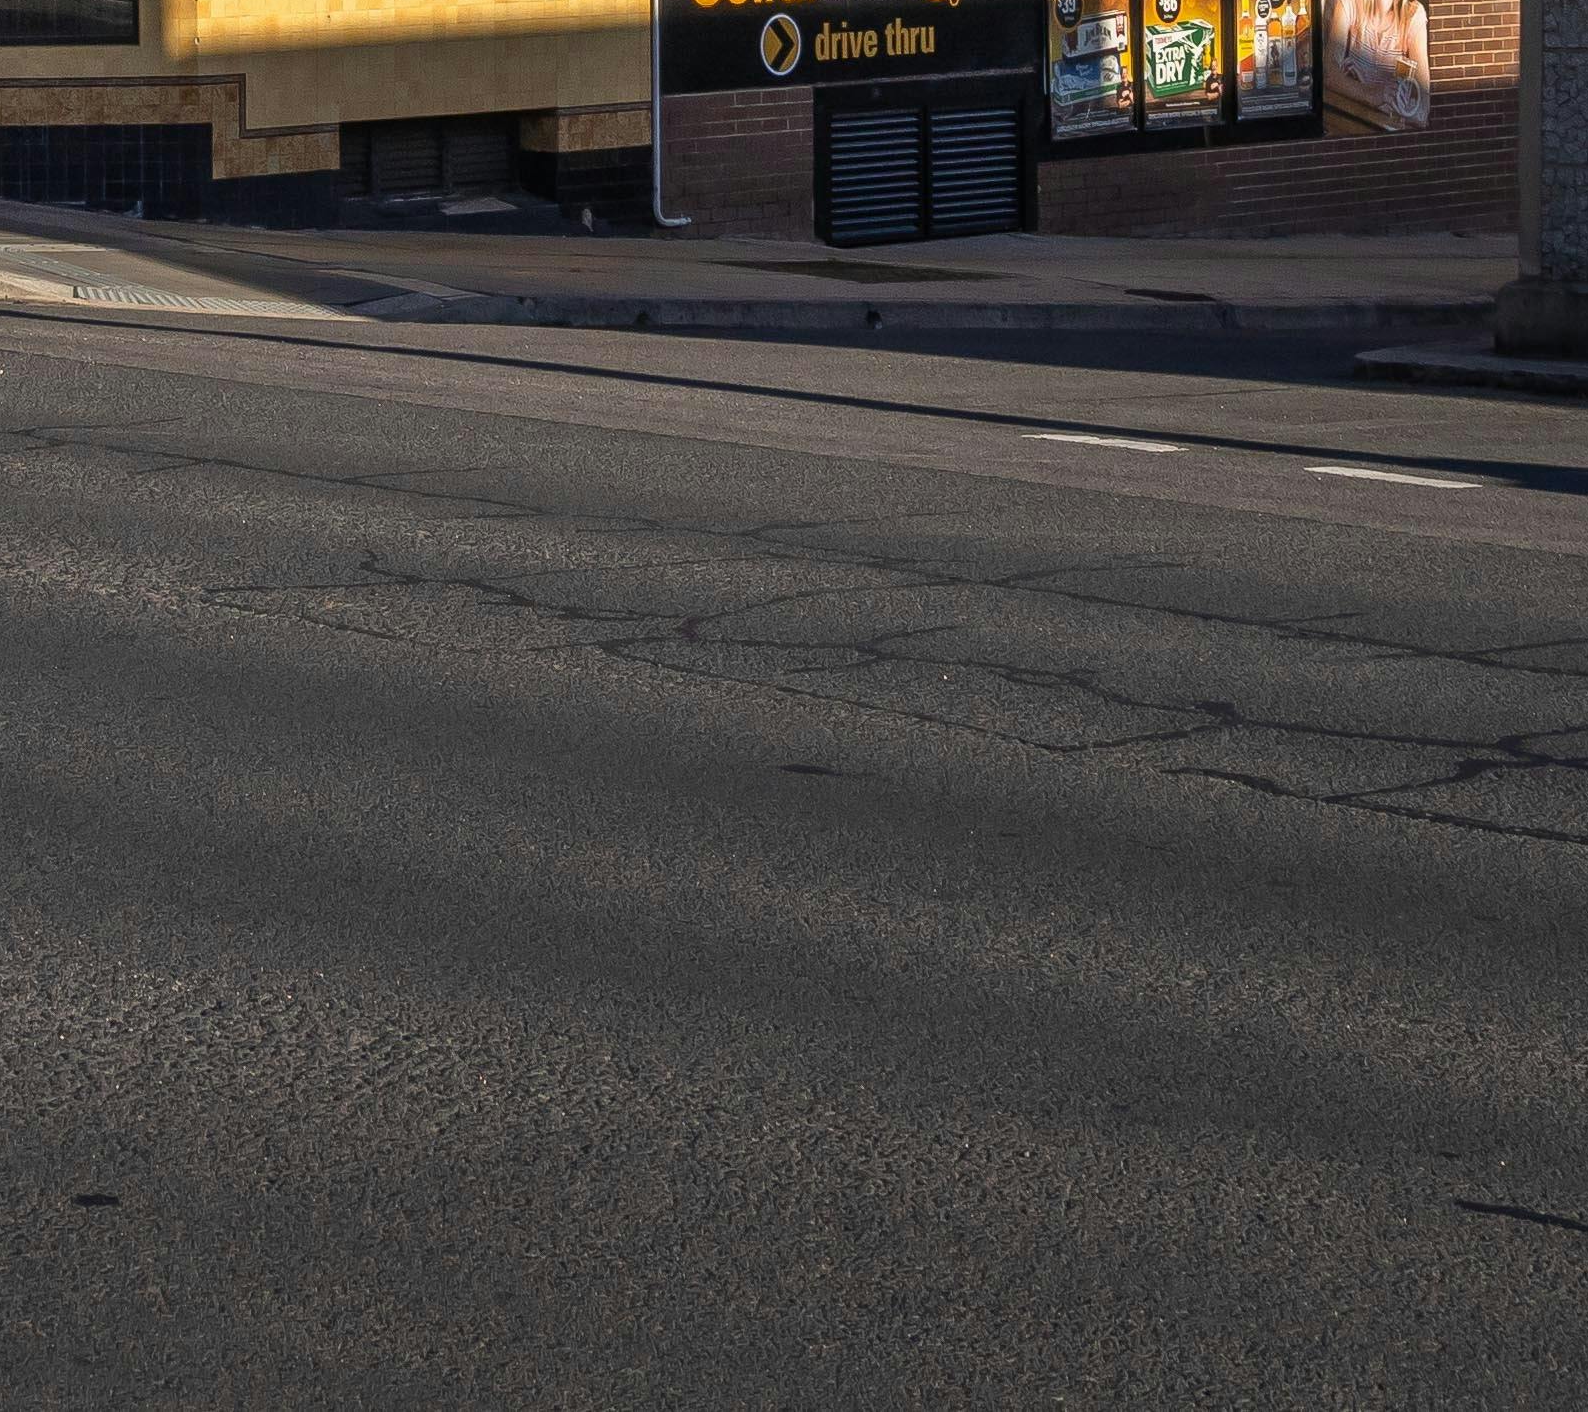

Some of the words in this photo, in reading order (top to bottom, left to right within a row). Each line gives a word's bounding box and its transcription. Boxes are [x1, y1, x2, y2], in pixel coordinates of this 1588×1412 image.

[815, 21, 877, 61] drive
[884, 17, 935, 57] thru
[1156, 45, 1186, 63] EXTRA
[1156, 60, 1186, 85] DRY
